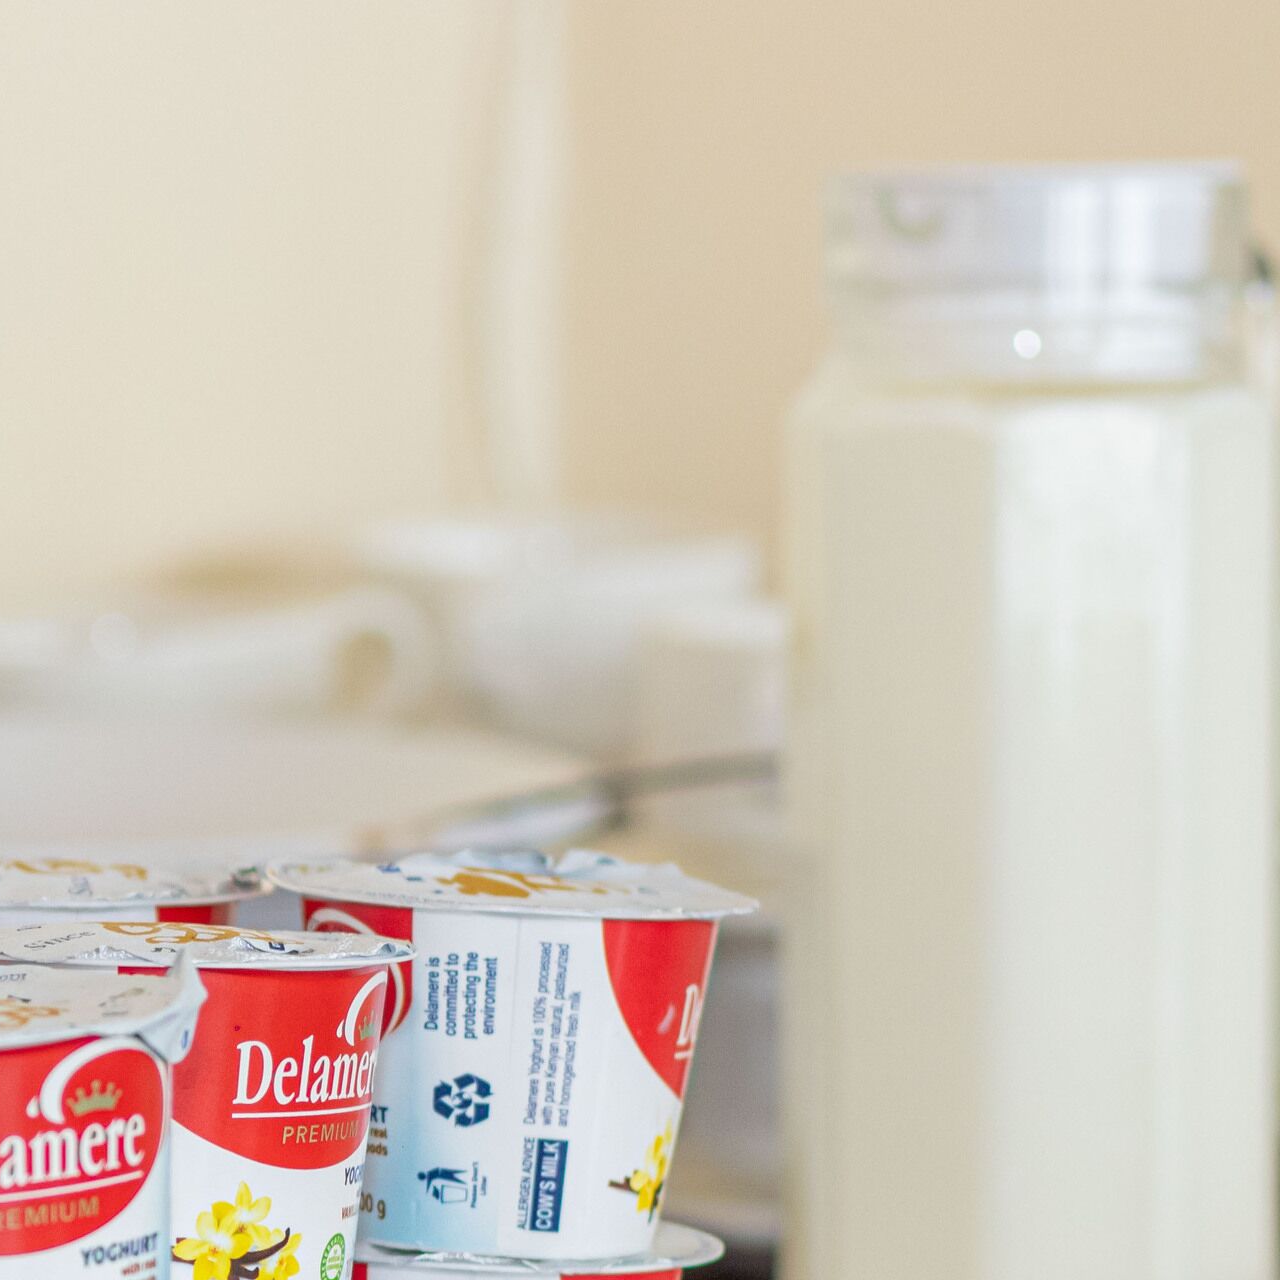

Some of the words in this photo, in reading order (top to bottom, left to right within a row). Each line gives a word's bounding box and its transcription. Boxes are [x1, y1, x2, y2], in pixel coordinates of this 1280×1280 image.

[425, 957, 440, 967] is
[445, 953, 459, 965] to
[463, 952, 479, 971] the
[424, 970, 440, 1030] Delamere
[444, 969, 459, 1036] committed
[462, 975, 481, 1039] protecting
[481, 957, 498, 1035] environment
[232, 1035, 376, 1105] Delamer
[282, 1119, 359, 1146] PREMIUM
[522, 1137, 535, 1174] ADVICE
[540, 1141, 560, 1178] MILK
[517, 1176, 531, 1230] ALLERGEN
[535, 1180, 556, 1230] COW'S
